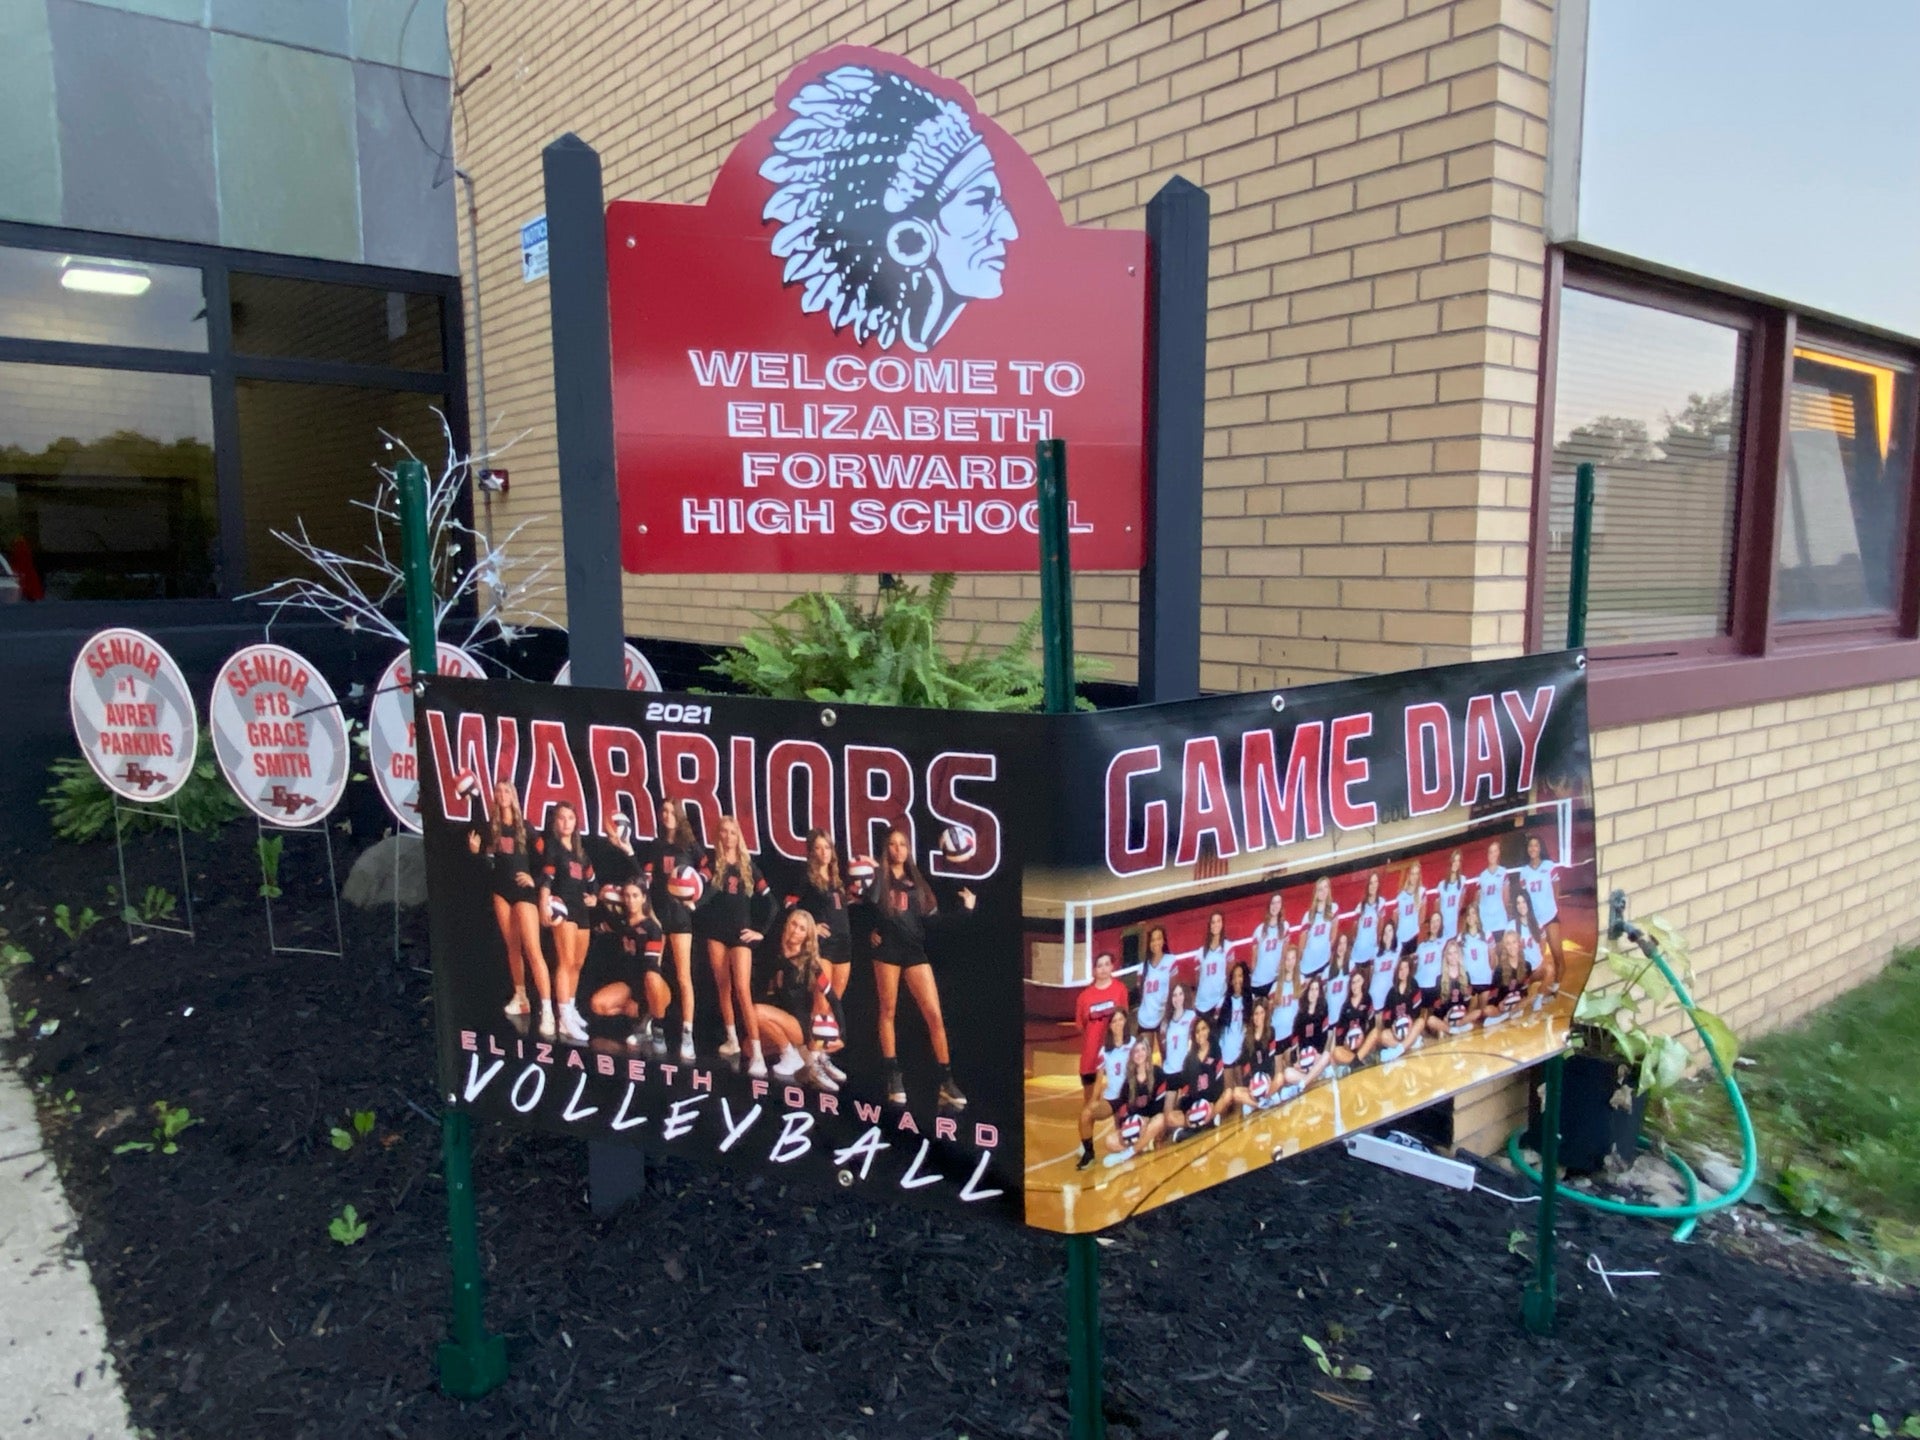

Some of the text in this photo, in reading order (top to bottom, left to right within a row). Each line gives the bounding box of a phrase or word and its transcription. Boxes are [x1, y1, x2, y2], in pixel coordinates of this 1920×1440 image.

[688, 349, 1085, 397] WELCOME TO
[727, 401, 1053, 442] ELIZABETH
[742, 452, 1038, 489] FORWARD
[682, 497, 834, 535] HIGH
[85, 638, 161, 679] SENIOR
[226, 655, 310, 698] SENIOR
[118, 675, 136, 698] #1
[254, 692, 290, 716] #18
[106, 703, 158, 727] AVREY
[645, 702, 712, 725] 2021
[99, 732, 174, 757] PARKINS
[246, 722, 309, 748] GRACE
[253, 753, 312, 778] SMITH
[1105, 685, 1556, 878] GAME DAY
[426, 709, 1001, 881] WARRIORS
[460, 1030, 1000, 1149] ELIZABETH FORWARD
[462, 1052, 1005, 1202] VOLLEYBALL
